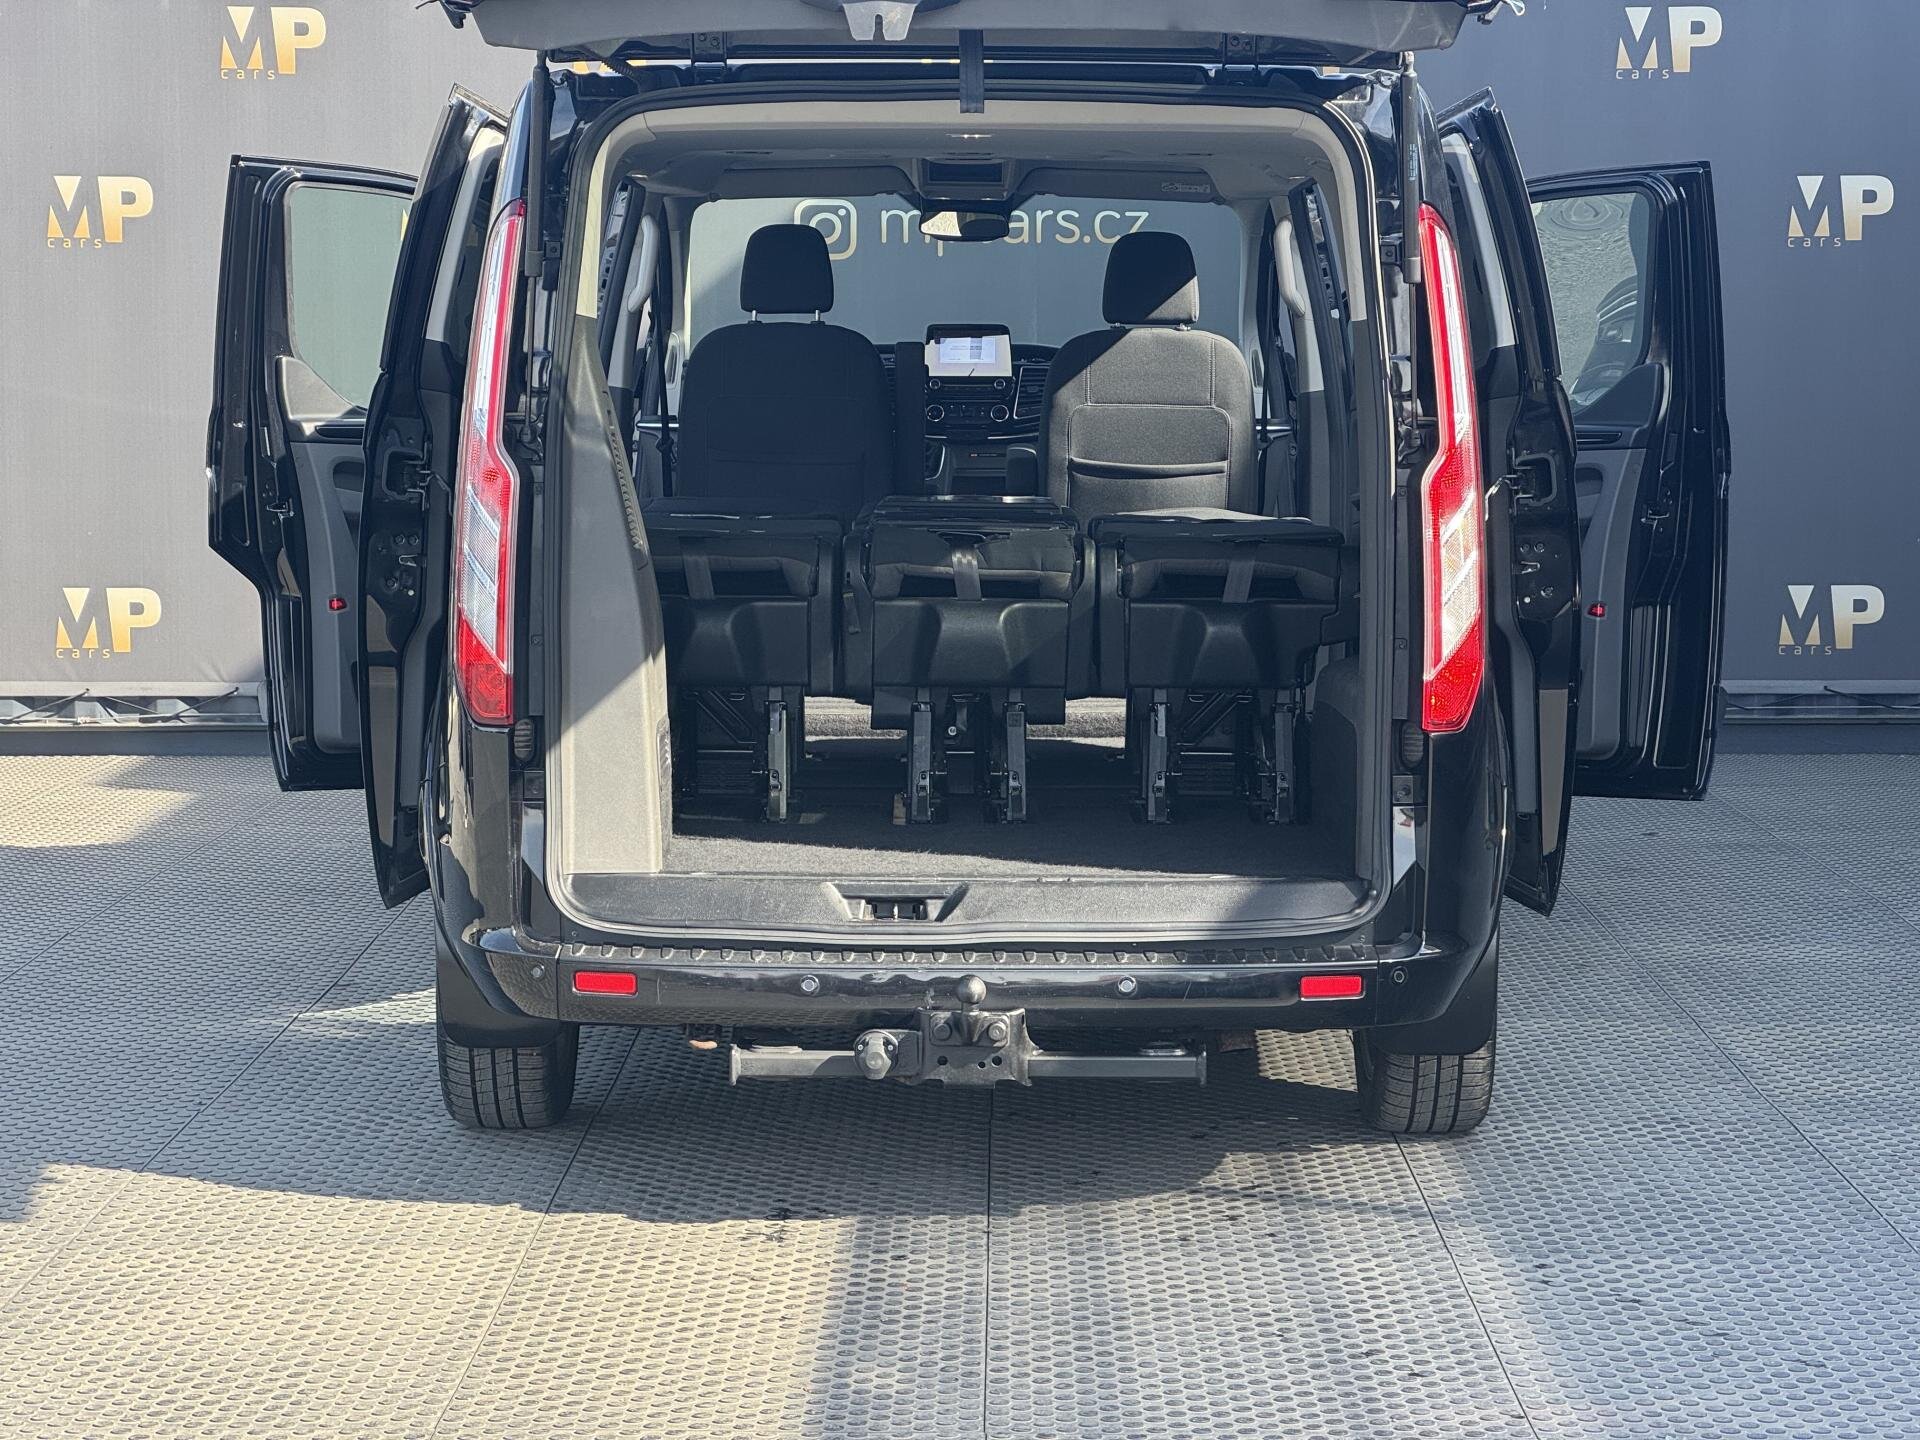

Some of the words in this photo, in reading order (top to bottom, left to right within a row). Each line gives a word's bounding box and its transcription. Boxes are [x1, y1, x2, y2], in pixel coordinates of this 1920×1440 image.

[221, 6, 326, 74] MP
[1616, 6, 1722, 72] MP
[221, 69, 275, 80] cars
[1616, 69, 1669, 79] cars
[47, 176, 153, 242] MP
[1788, 175, 1894, 240] MP
[47, 238, 102, 248] cars
[881, 209, 1149, 257] mars.cz
[1788, 237, 1841, 247] cars
[56, 587, 162, 652] MP
[1779, 585, 1885, 649] MP
[56, 648, 110, 659] cars
[1779, 646, 1832, 655] cars
